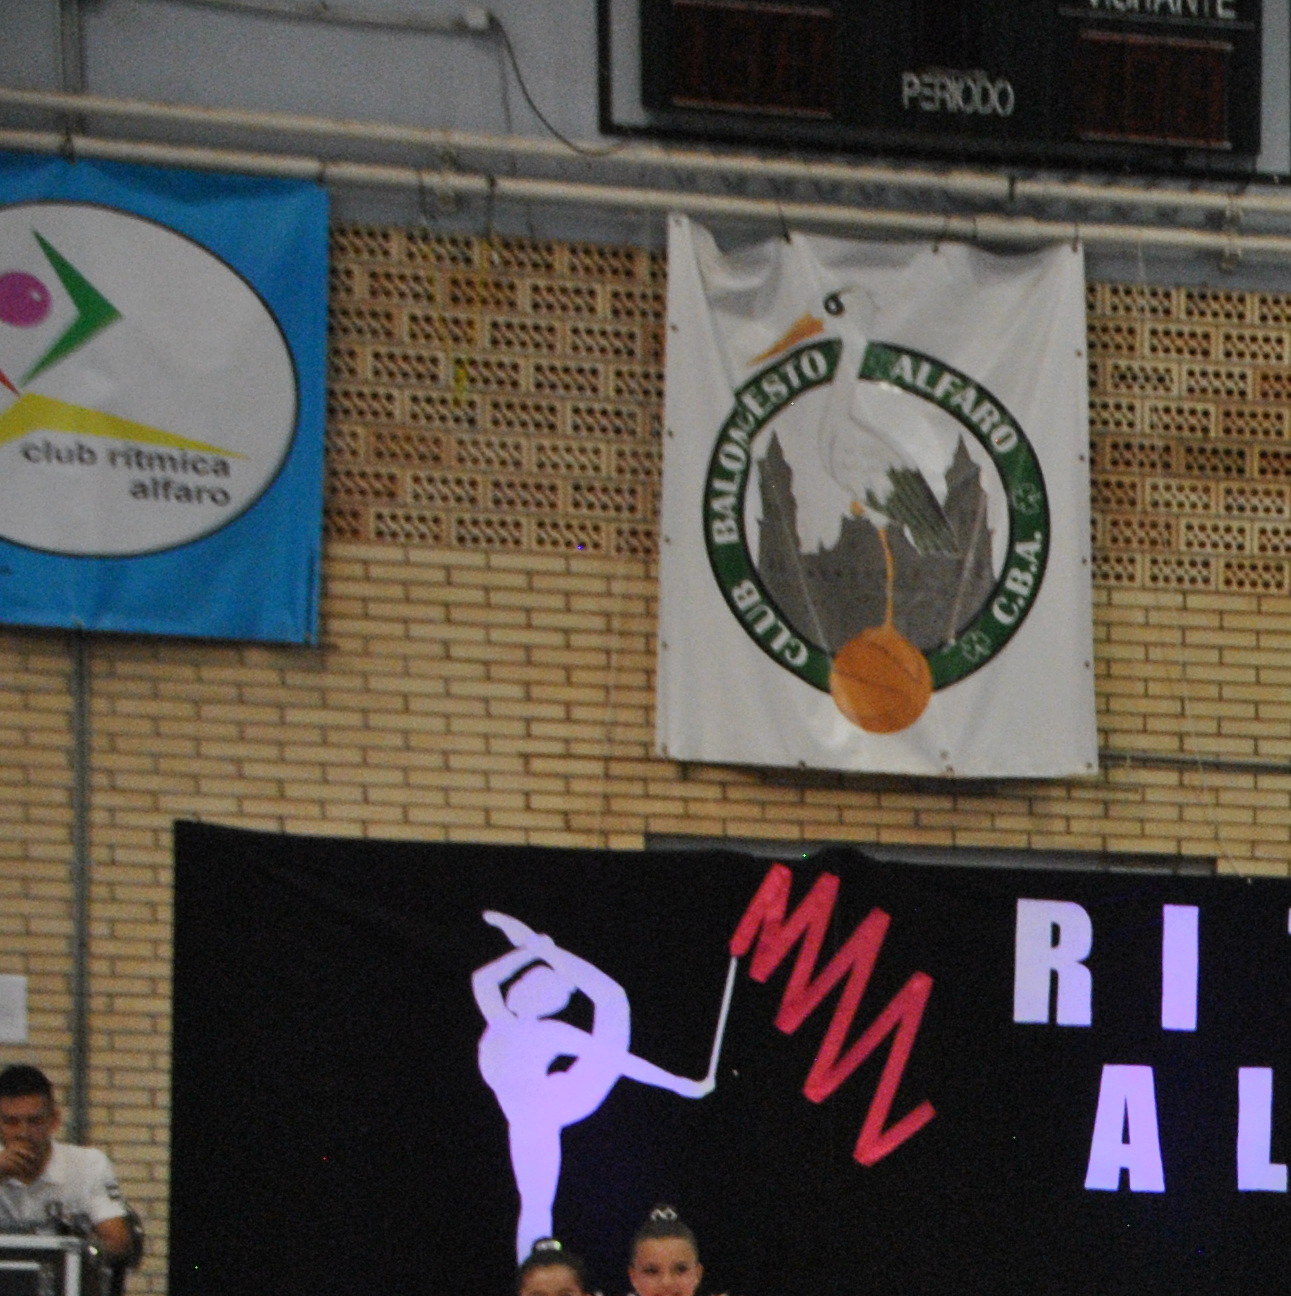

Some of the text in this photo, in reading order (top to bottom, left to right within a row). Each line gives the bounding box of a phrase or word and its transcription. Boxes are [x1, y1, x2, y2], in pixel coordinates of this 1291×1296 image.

[890, 354, 1018, 453] ALFARO
[21, 440, 97, 465] club
[130, 477, 231, 507] alfaro
[731, 580, 808, 667] CLUB
